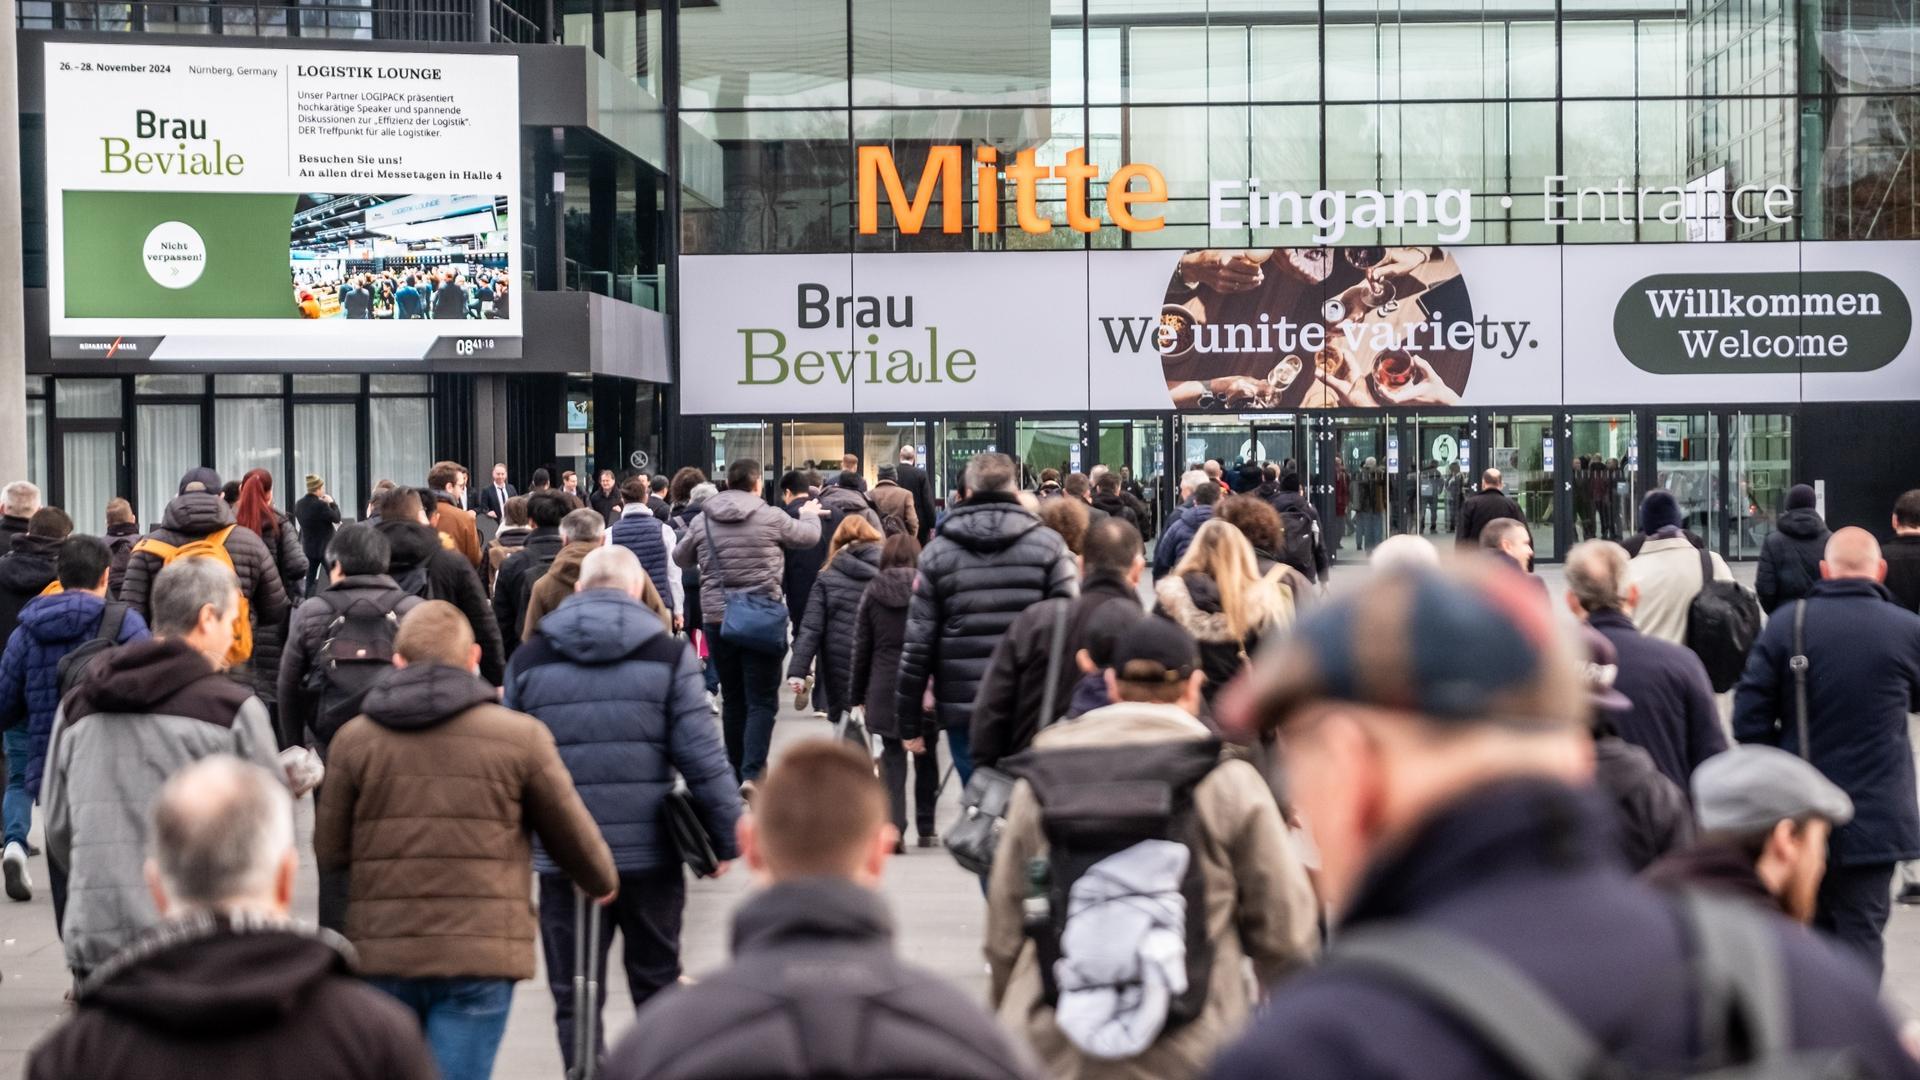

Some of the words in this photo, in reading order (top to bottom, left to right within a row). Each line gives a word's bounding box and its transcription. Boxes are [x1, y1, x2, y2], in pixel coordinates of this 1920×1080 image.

[96, 63, 146, 73] November
[149, 64, 171, 73] 2024
[189, 65, 234, 77] Nürnberg,
[237, 66, 278, 77] Germany
[298, 65, 373, 78] LOGISTIK
[378, 67, 442, 80] LOUNGE
[298, 91, 323, 100] Unser
[326, 91, 359, 101] Partner
[361, 92, 405, 102] LOGIPACK
[407, 93, 454, 106] präsentiert
[298, 102, 355, 114] hochkarätige
[357, 104, 392, 115] Speaker
[394, 104, 411, 113] und
[414, 105, 462, 116] spannende
[136, 109, 207, 139] Brau
[298, 114, 356, 124] Diskussionen
[416, 116, 430, 125] der
[298, 126, 316, 135] DER
[318, 126, 364, 137] Treffpunkt
[366, 127, 378, 136] für
[381, 128, 396, 136] alle
[398, 128, 442, 139] Logistiker.
[100, 137, 244, 176] Beviale
[299, 154, 354, 164] Besuchen
[357, 155, 375, 164] Sie
[378, 155, 402, 165] uns!
[299, 168, 315, 177] An
[318, 168, 347, 178] allen
[350, 168, 374, 178] drei
[377, 169, 446, 181] Messetagen
[449, 169, 460, 180] in
[463, 170, 493, 180] Halle
[496, 171, 502, 180] 4
[858, 144, 1168, 235] Mitte
[1210, 177, 1472, 243] Eingang
[1543, 174, 1794, 228] Entrance
[161, 242, 189, 250] Nicht
[147, 253, 202, 263] verpassen!
[797, 283, 914, 329] Brau
[1645, 287, 1882, 320] Willkommen
[1099, 316, 1178, 354] We
[1193, 311, 1326, 353] unite
[1341, 311, 1539, 358] variety.
[1678, 328, 1849, 359] Welcome
[737, 327, 977, 386] Beviale
